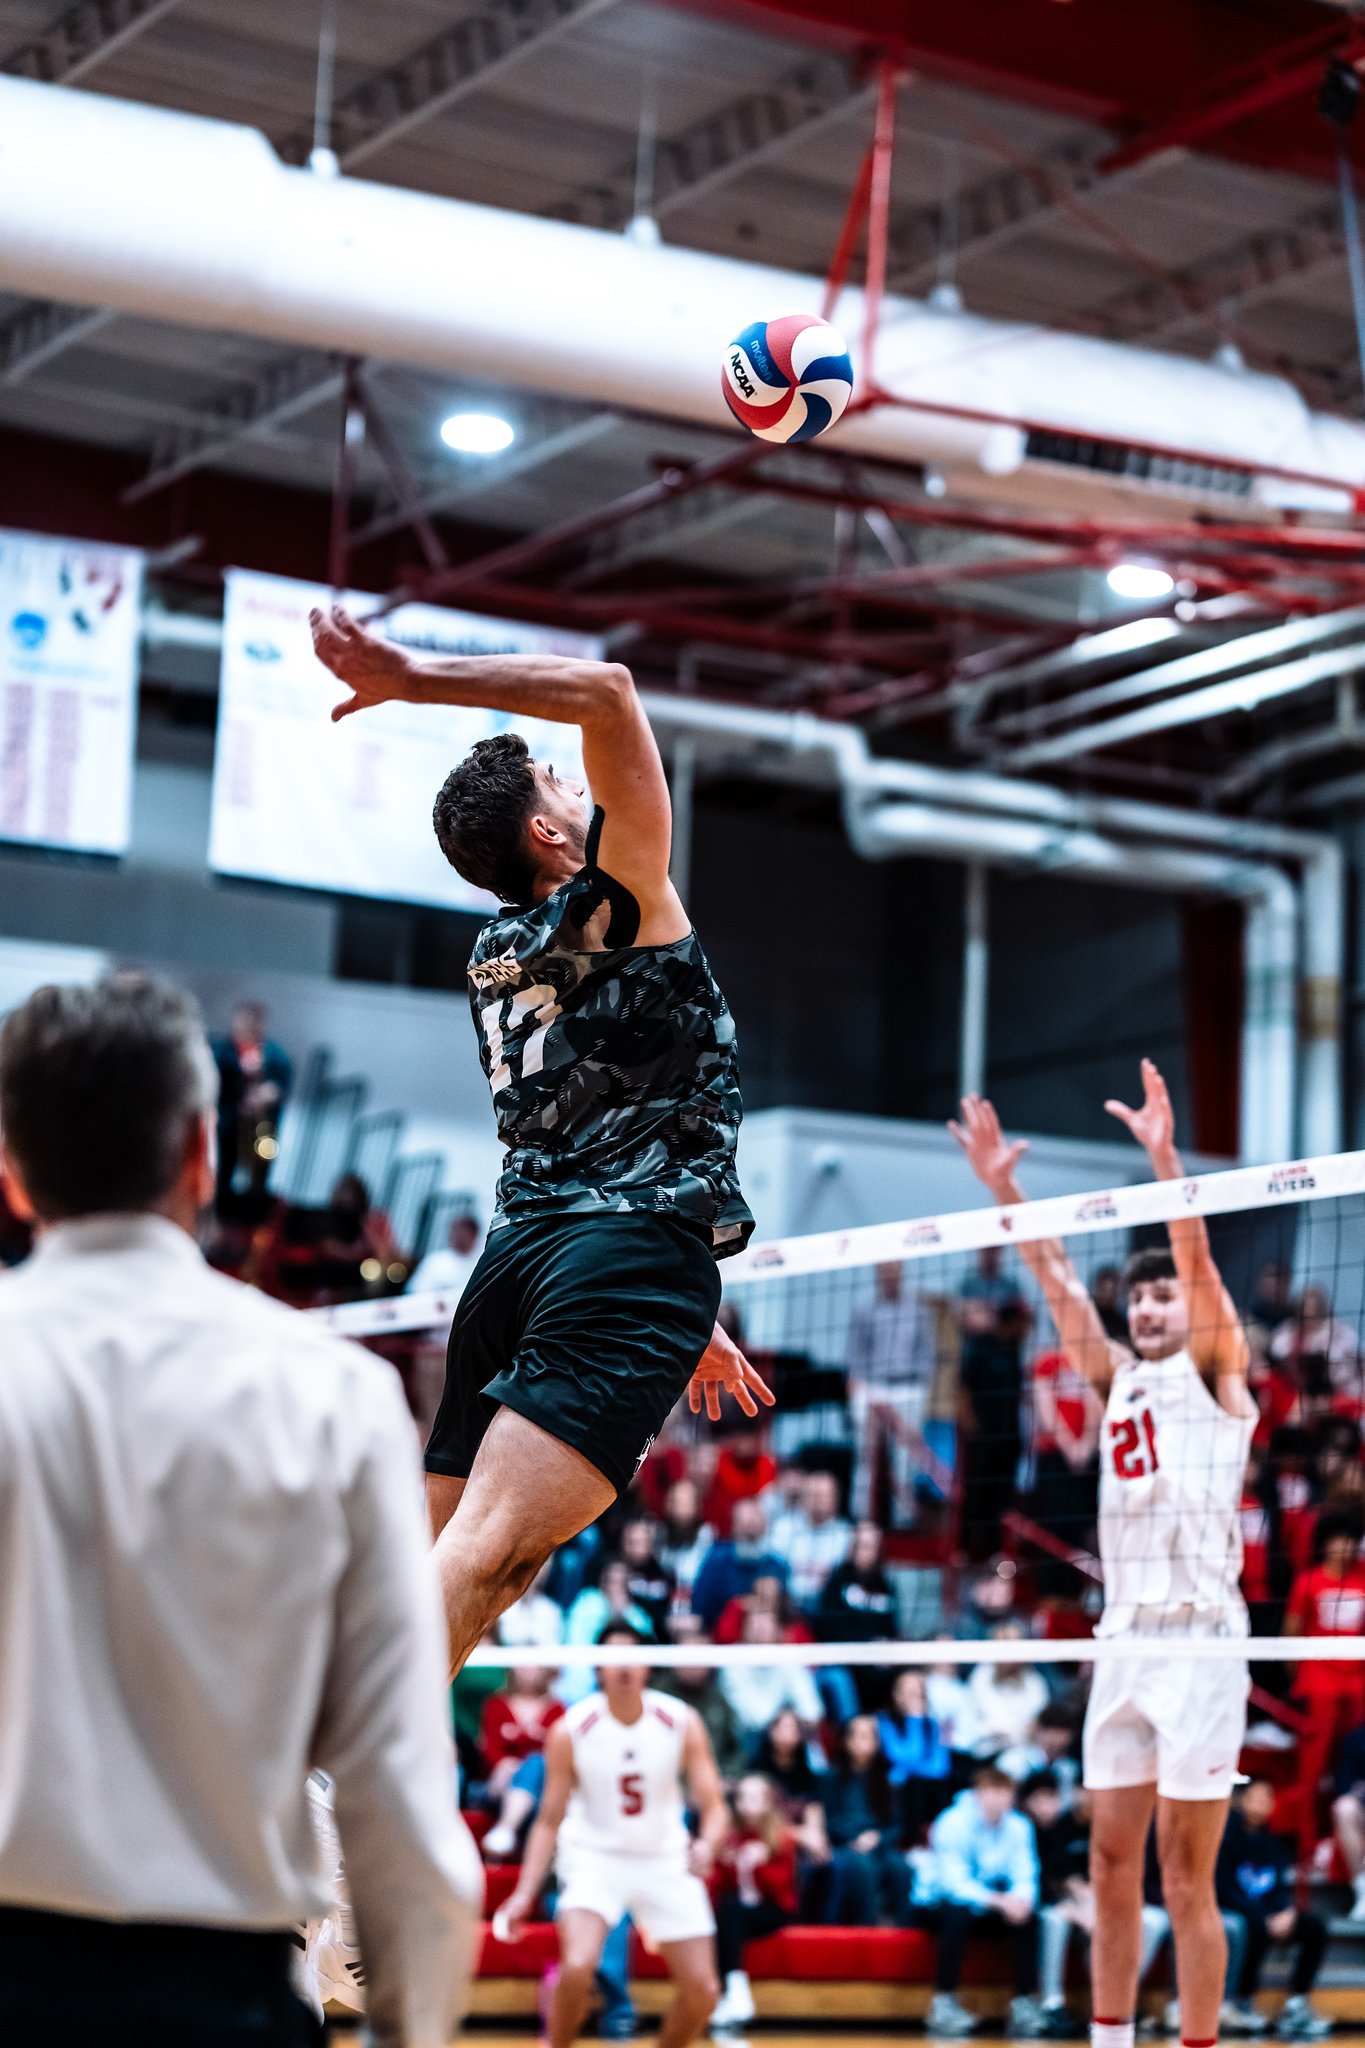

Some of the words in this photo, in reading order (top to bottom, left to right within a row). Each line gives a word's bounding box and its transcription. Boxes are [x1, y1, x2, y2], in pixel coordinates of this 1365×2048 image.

[730, 352, 756, 399] NCAA
[750, 339, 773, 381] molten
[1109, 1408, 1159, 1480] 21
[619, 1772, 644, 1817] 5
